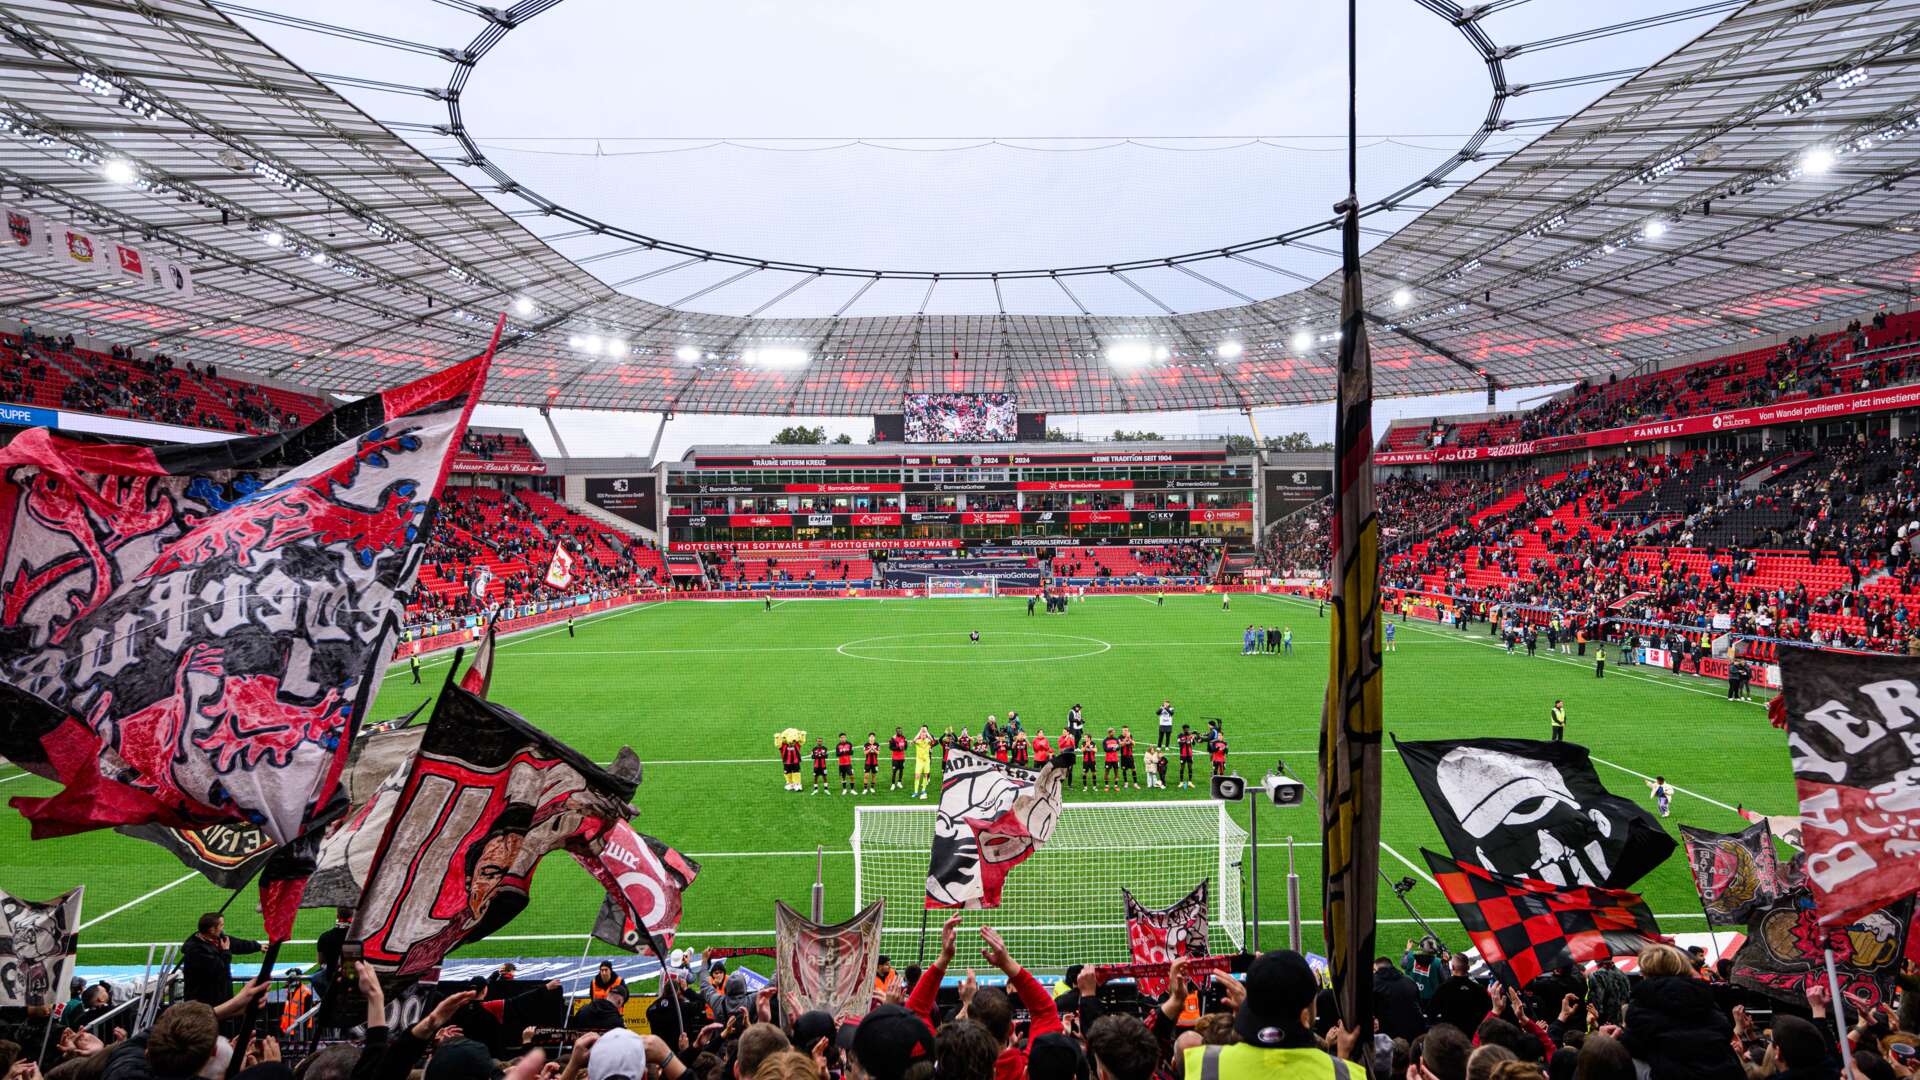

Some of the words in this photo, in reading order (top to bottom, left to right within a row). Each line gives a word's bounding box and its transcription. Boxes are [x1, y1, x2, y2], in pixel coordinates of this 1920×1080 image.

[1759, 411, 1775, 421] Vom
[1776, 408, 1803, 418] Wandel
[1804, 402, 1844, 417] profitieren
[1851, 397, 1871, 411] jetzt
[1633, 423, 1684, 438] FANWELT
[1382, 452, 1432, 462] FANWEL
[752, 541, 804, 550] SOFTWARE
[830, 541, 900, 549] HOTTGENROTH
[903, 540, 953, 548] SOFTWARE
